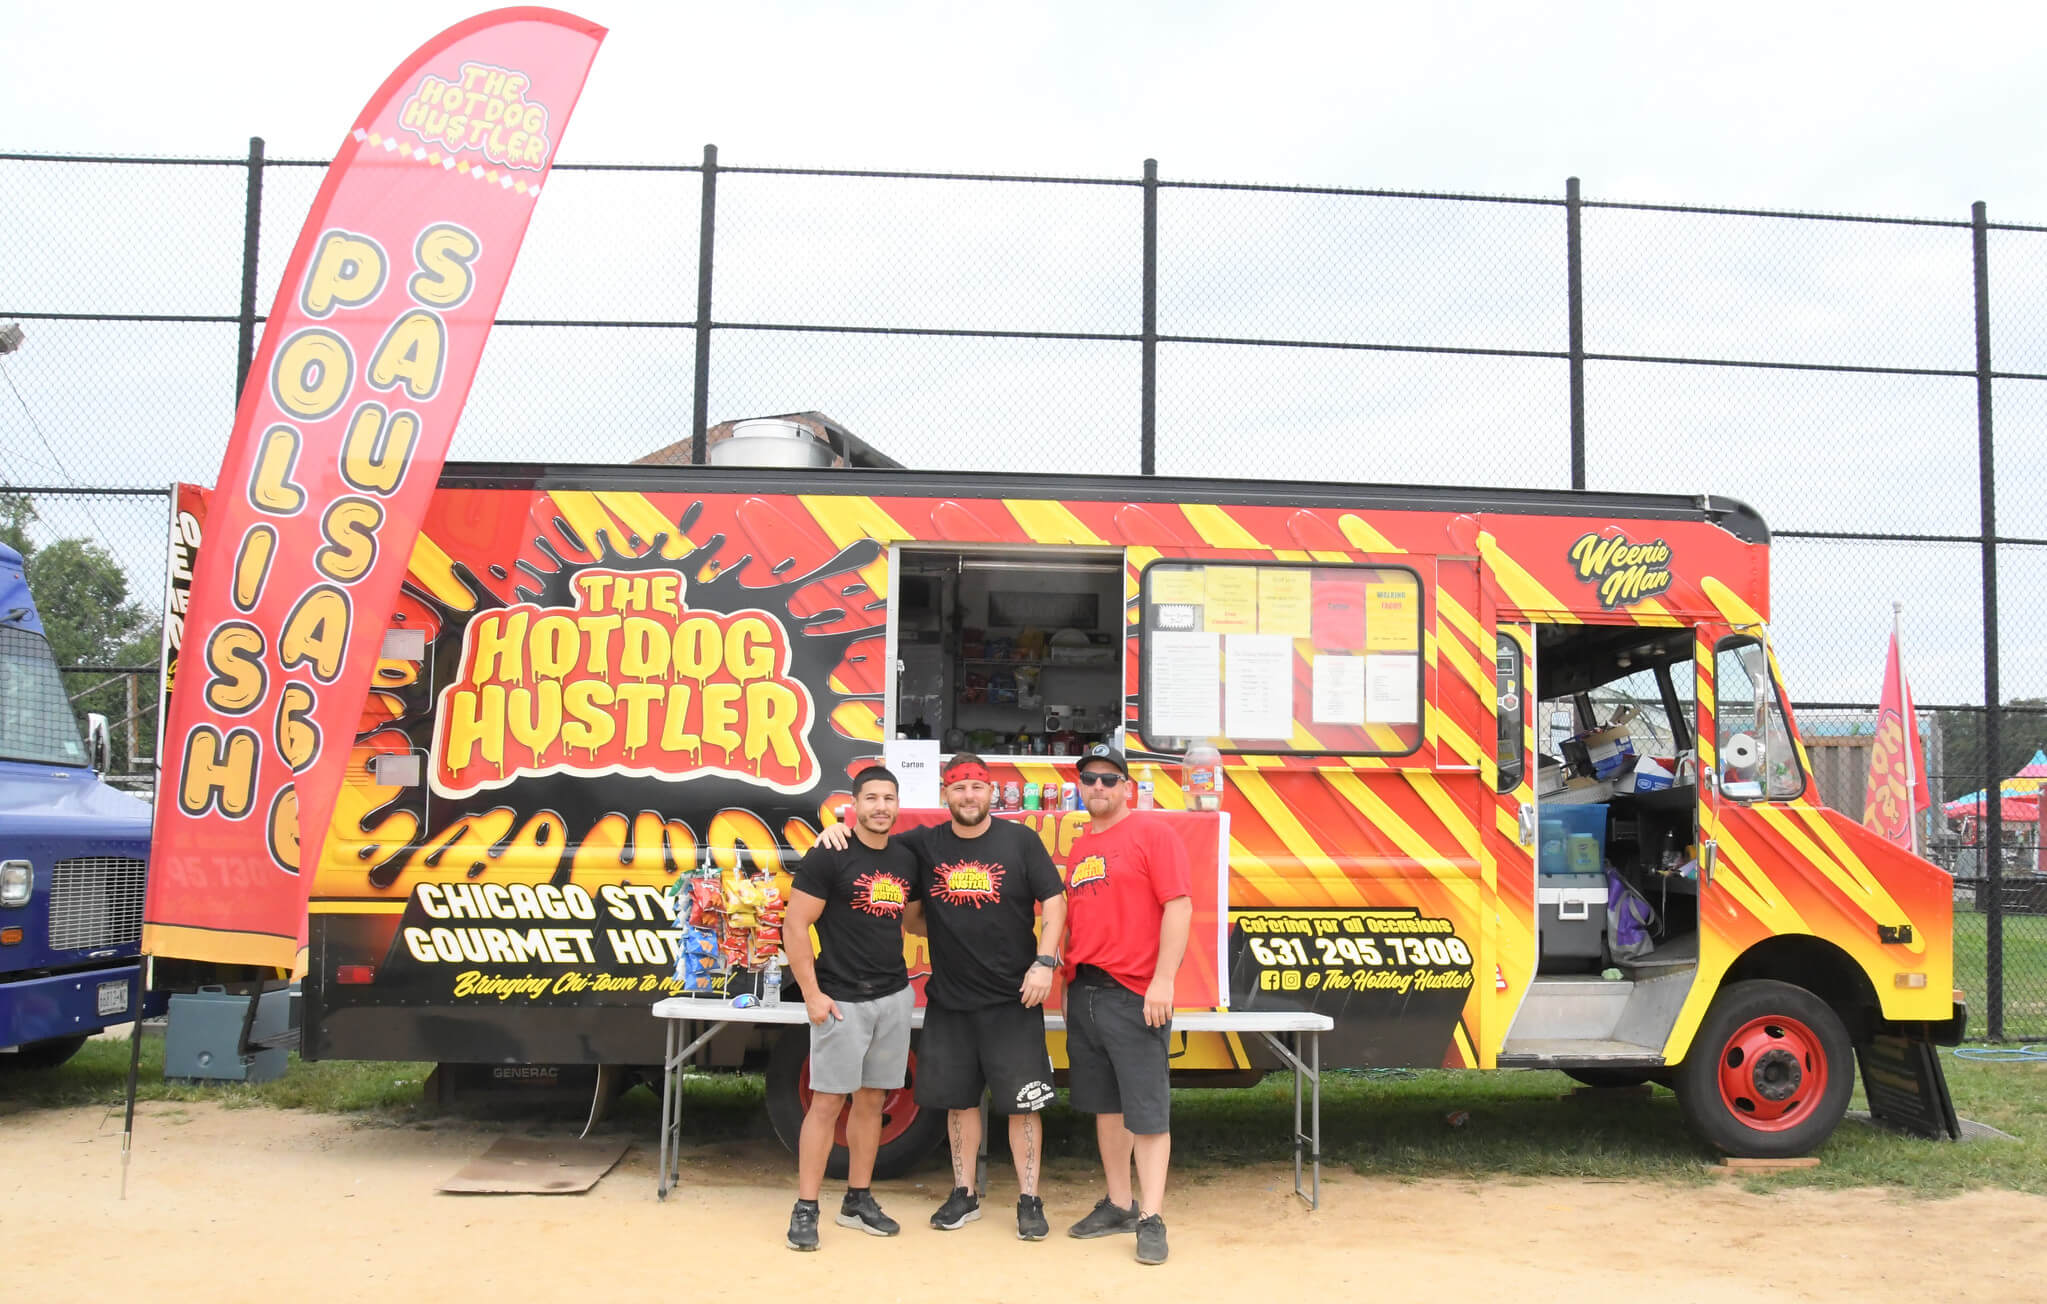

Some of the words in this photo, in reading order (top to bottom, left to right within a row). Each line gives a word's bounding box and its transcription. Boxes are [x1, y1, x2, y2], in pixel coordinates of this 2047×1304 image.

[463, 66, 525, 104] THE
[420, 79, 544, 134] HOTDOG
[404, 100, 545, 165] HUSTLER
[179, 230, 388, 820] POLISH
[1571, 533, 1671, 577] Weenie
[577, 575, 682, 624] THE
[1600, 564, 1671, 606] Man
[472, 611, 778, 692] HOTDOG
[446, 679, 802, 780] HUSTLER
[900, 760, 925, 769] Carton
[948, 879, 991, 892] HUSTLER
[951, 871, 988, 881] HOTDOG
[416, 883, 597, 920] CHICAGO
[1342, 917, 1365, 933] all
[404, 926, 596, 964] GOURMET
[1249, 937, 1473, 966] 631.295.7308
[454, 971, 553, 998] Bringing
[553, 971, 638, 995] Chi-town
[640, 974, 658, 991] to
[1322, 970, 1353, 991] The
[1352, 970, 1415, 994] Hotdog
[1414, 970, 1474, 990] Hustler
[494, 1068, 558, 1078] GENERAC
